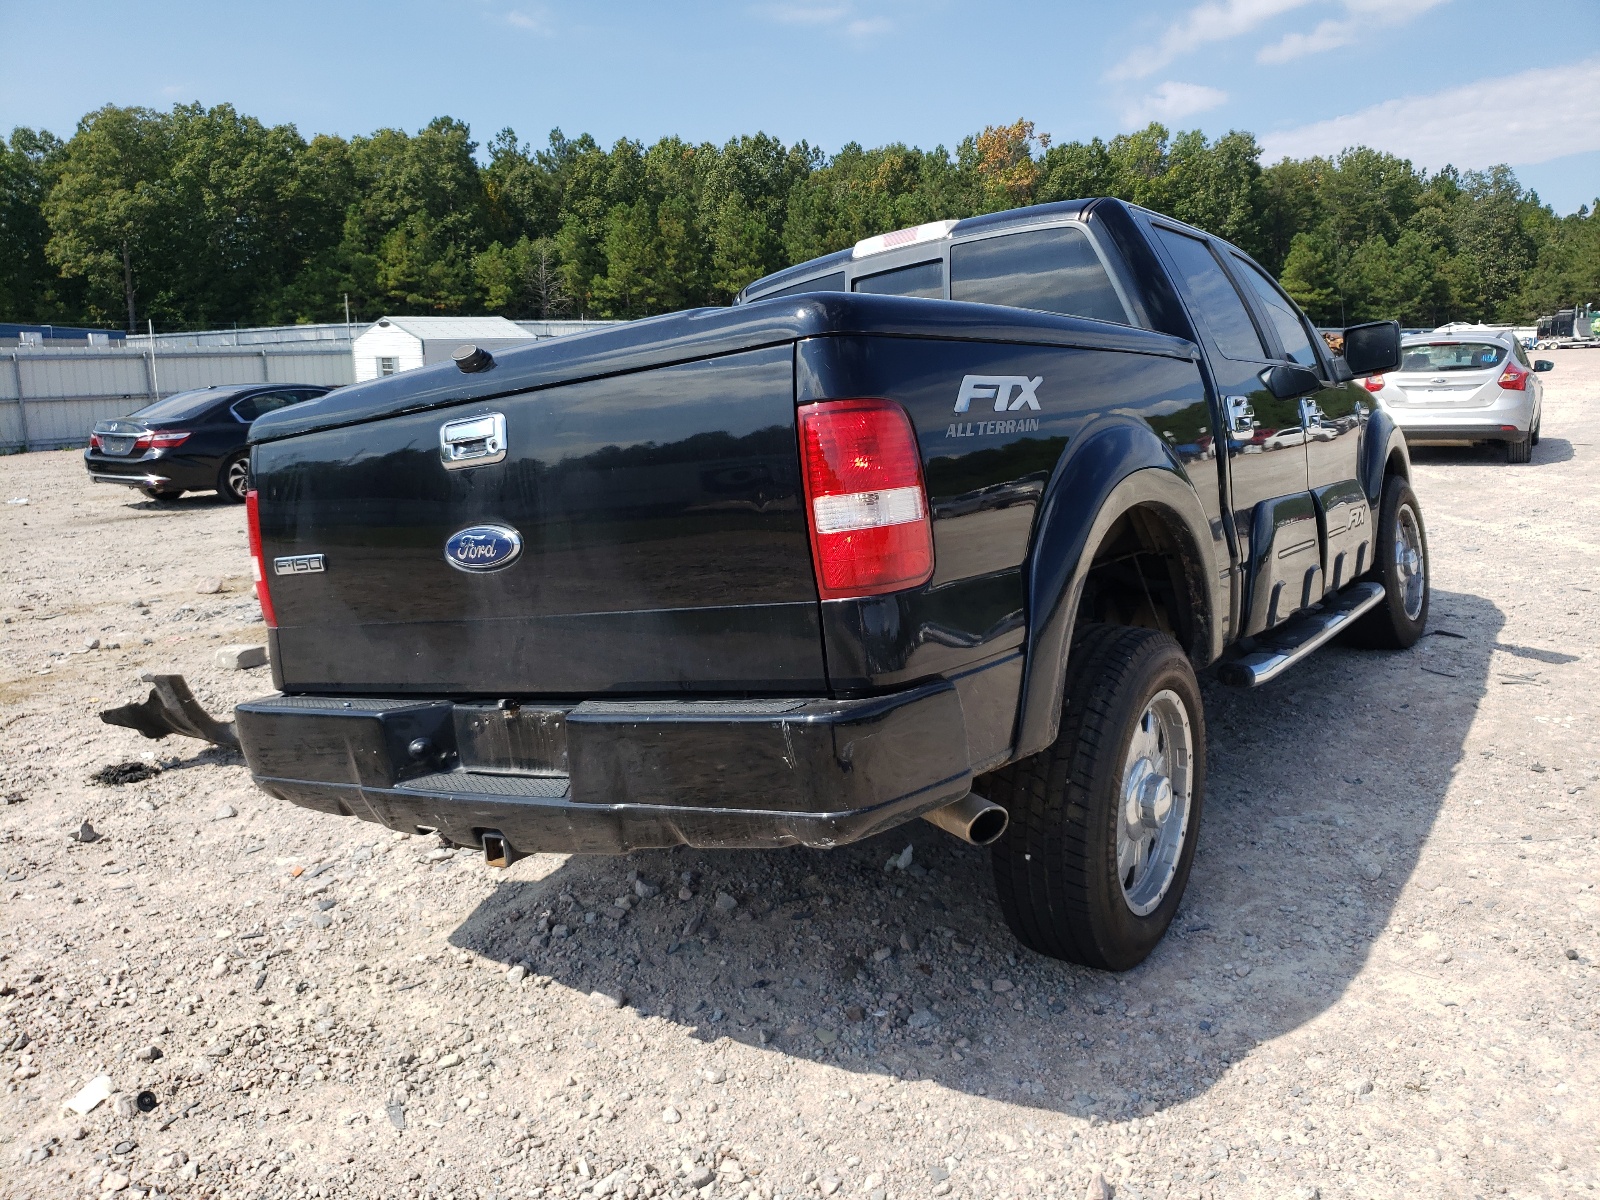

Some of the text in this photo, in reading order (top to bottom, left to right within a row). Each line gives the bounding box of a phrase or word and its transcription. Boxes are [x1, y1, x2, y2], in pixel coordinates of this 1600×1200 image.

[953, 374, 1044, 413] FTX
[945, 418, 1040, 439] ALL TERRAIN
[457, 534, 497, 560] Ford
